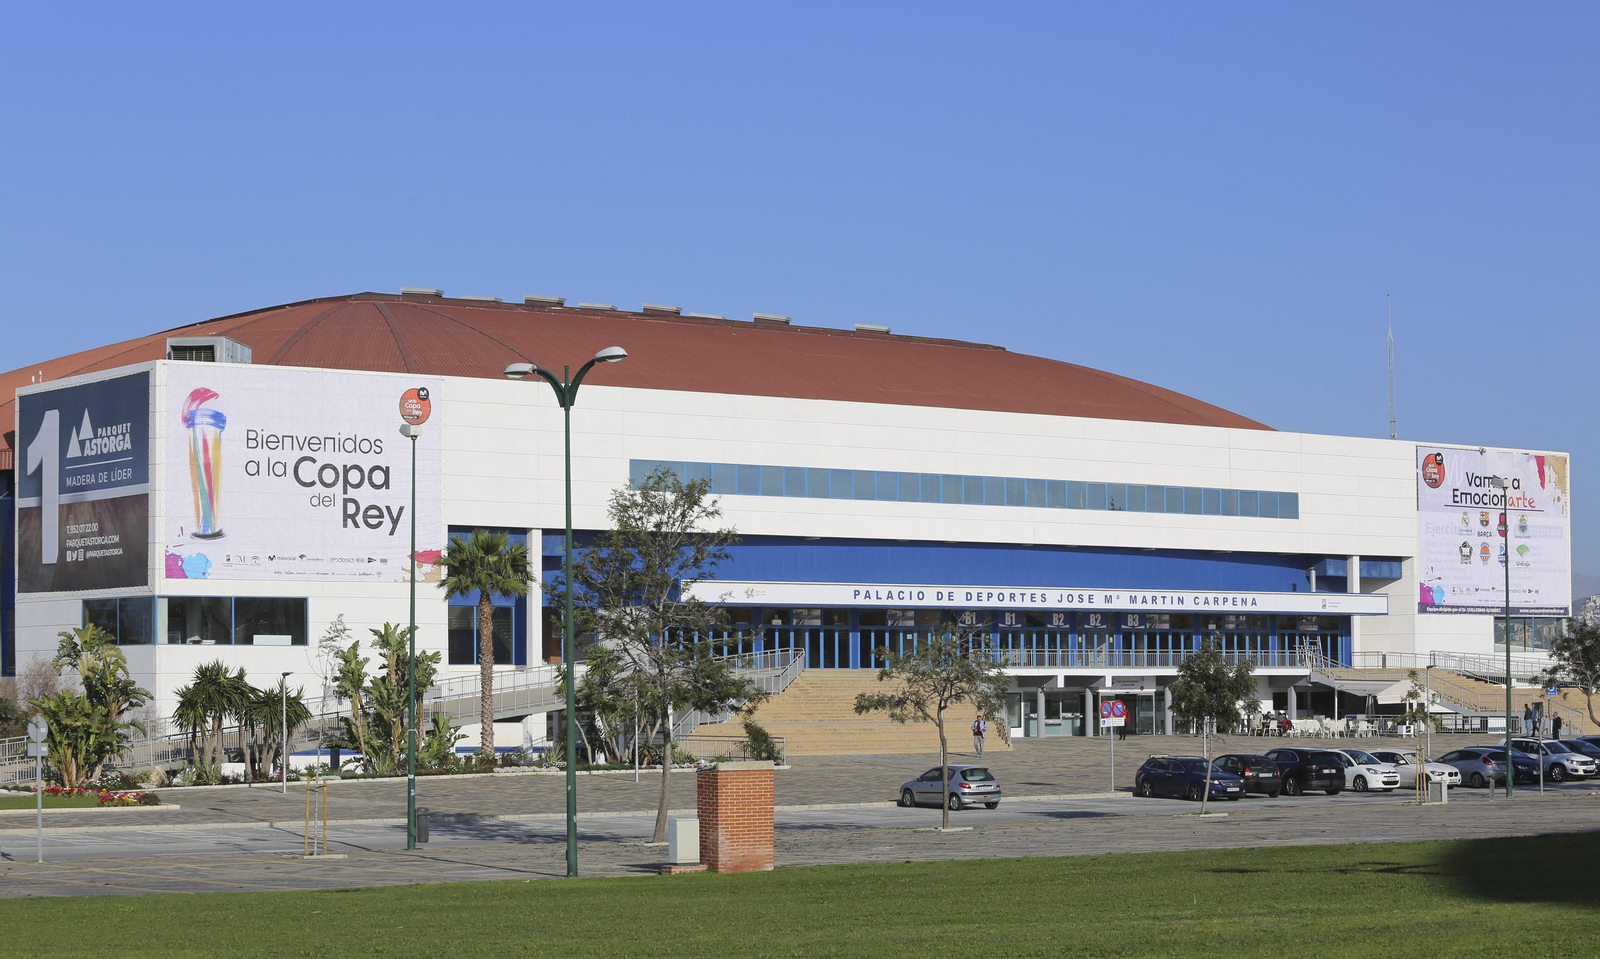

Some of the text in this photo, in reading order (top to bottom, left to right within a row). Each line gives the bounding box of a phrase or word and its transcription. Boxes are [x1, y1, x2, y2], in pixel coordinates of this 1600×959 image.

[404, 402, 421, 411] Copa
[97, 422, 131, 438] PARQUET
[83, 432, 132, 457] ASTORGA
[246, 428, 383, 455] Bienvenidos
[66, 467, 132, 488] MADERA DE LÍDER
[245, 455, 390, 495] a la Copa
[1465, 472, 1521, 490] Vam a
[309, 493, 405, 536] del Rey
[91, 522, 99, 532] 00
[66, 534, 120, 548] PARQUETASTORGA.COM
[853, 589, 925, 601] PALACIO
[936, 590, 955, 602] DE
[965, 591, 1047, 603] DEPORTES
[1057, 593, 1095, 604] JOSE
[1129, 594, 1185, 606] MARTIN
[1193, 595, 1258, 607] CARPENA
[1005, 612, 1016, 625] B1
[1052, 613, 1065, 626] B2
[1089, 613, 1102, 627] B2
[1127, 614, 1139, 627] B3
